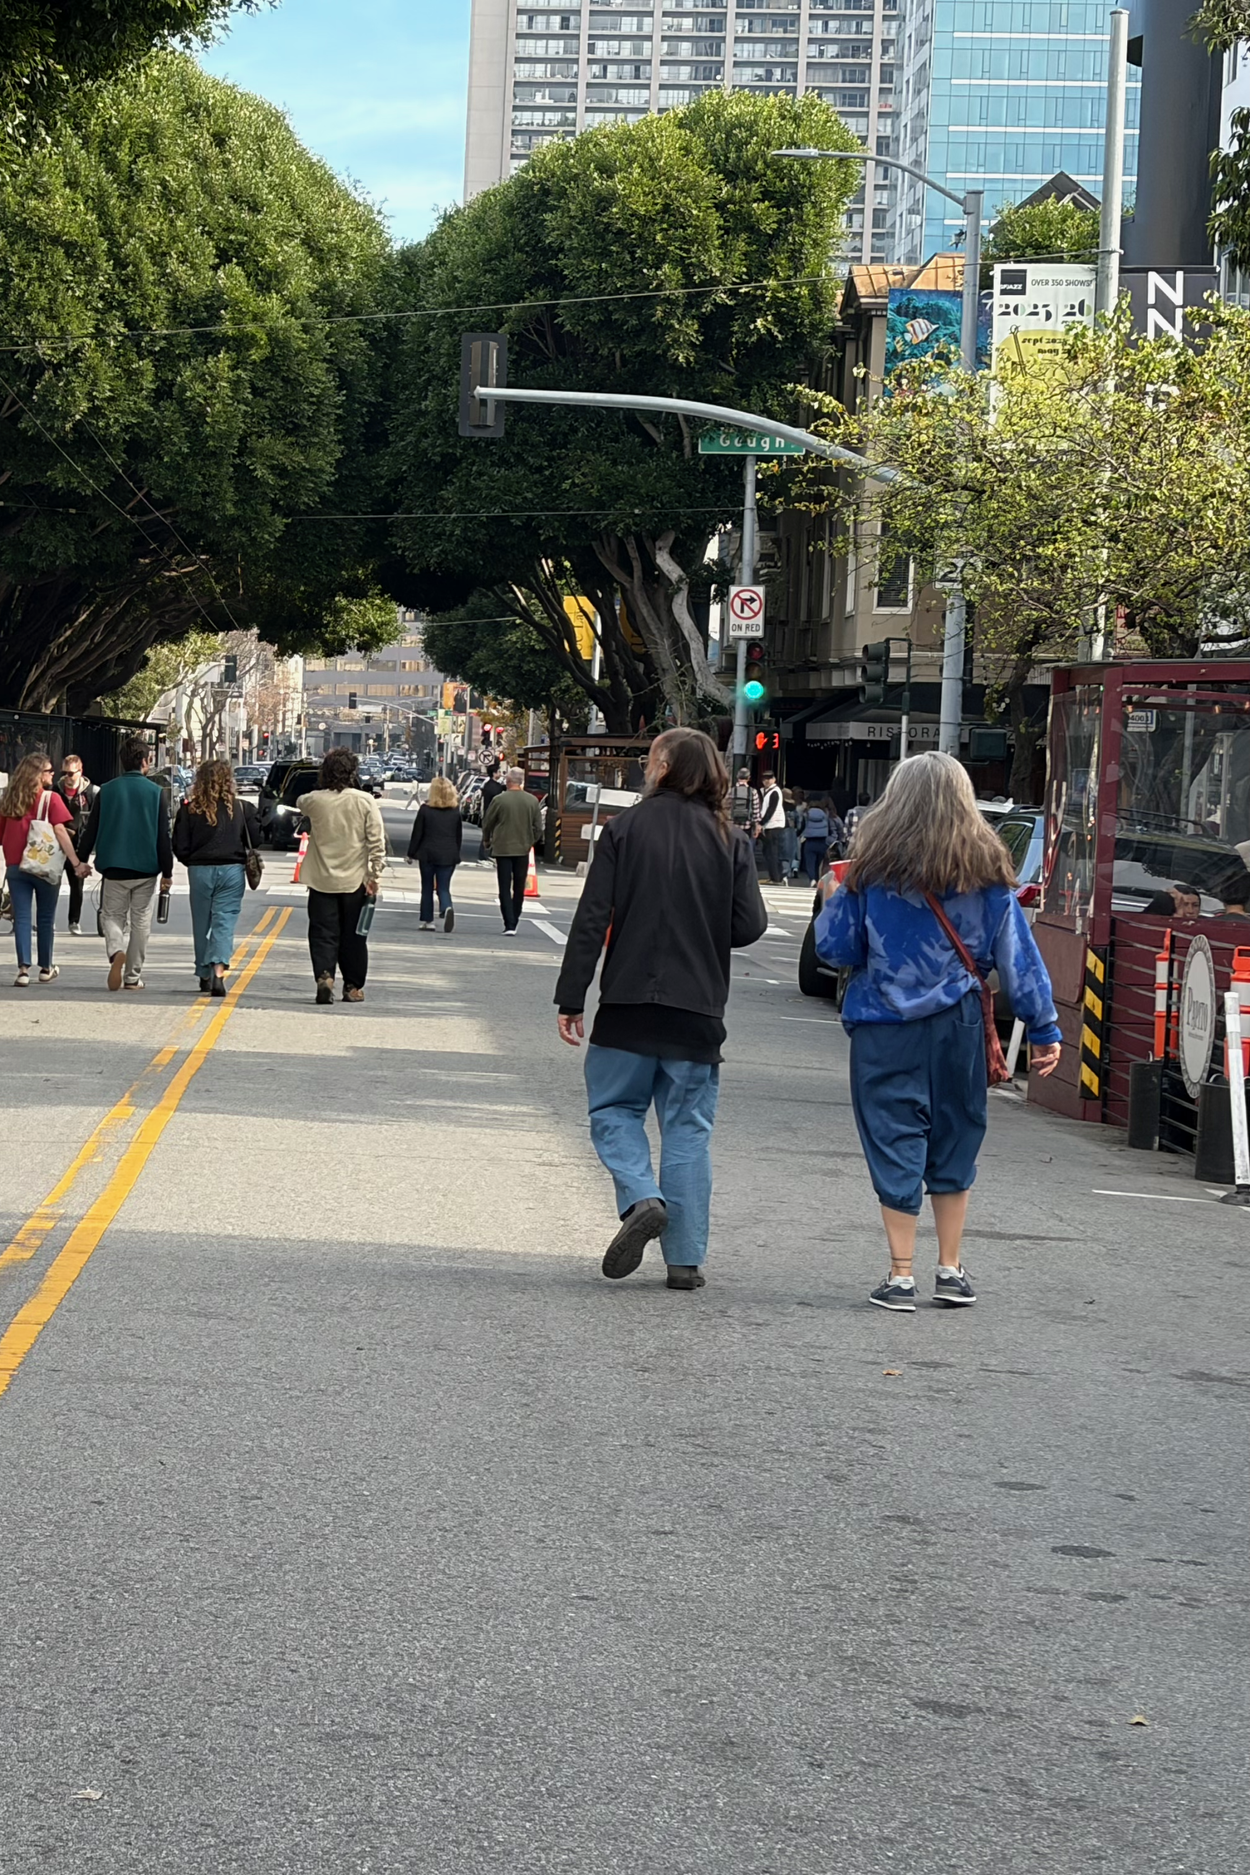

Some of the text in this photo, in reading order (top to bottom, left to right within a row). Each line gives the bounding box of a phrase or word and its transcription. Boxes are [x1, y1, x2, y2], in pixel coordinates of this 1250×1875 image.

[1031, 279, 1050, 287] OVER
[1051, 279, 1064, 287] 350
[731, 623, 761, 632] ON RED
[772, 732, 780, 749] 3
